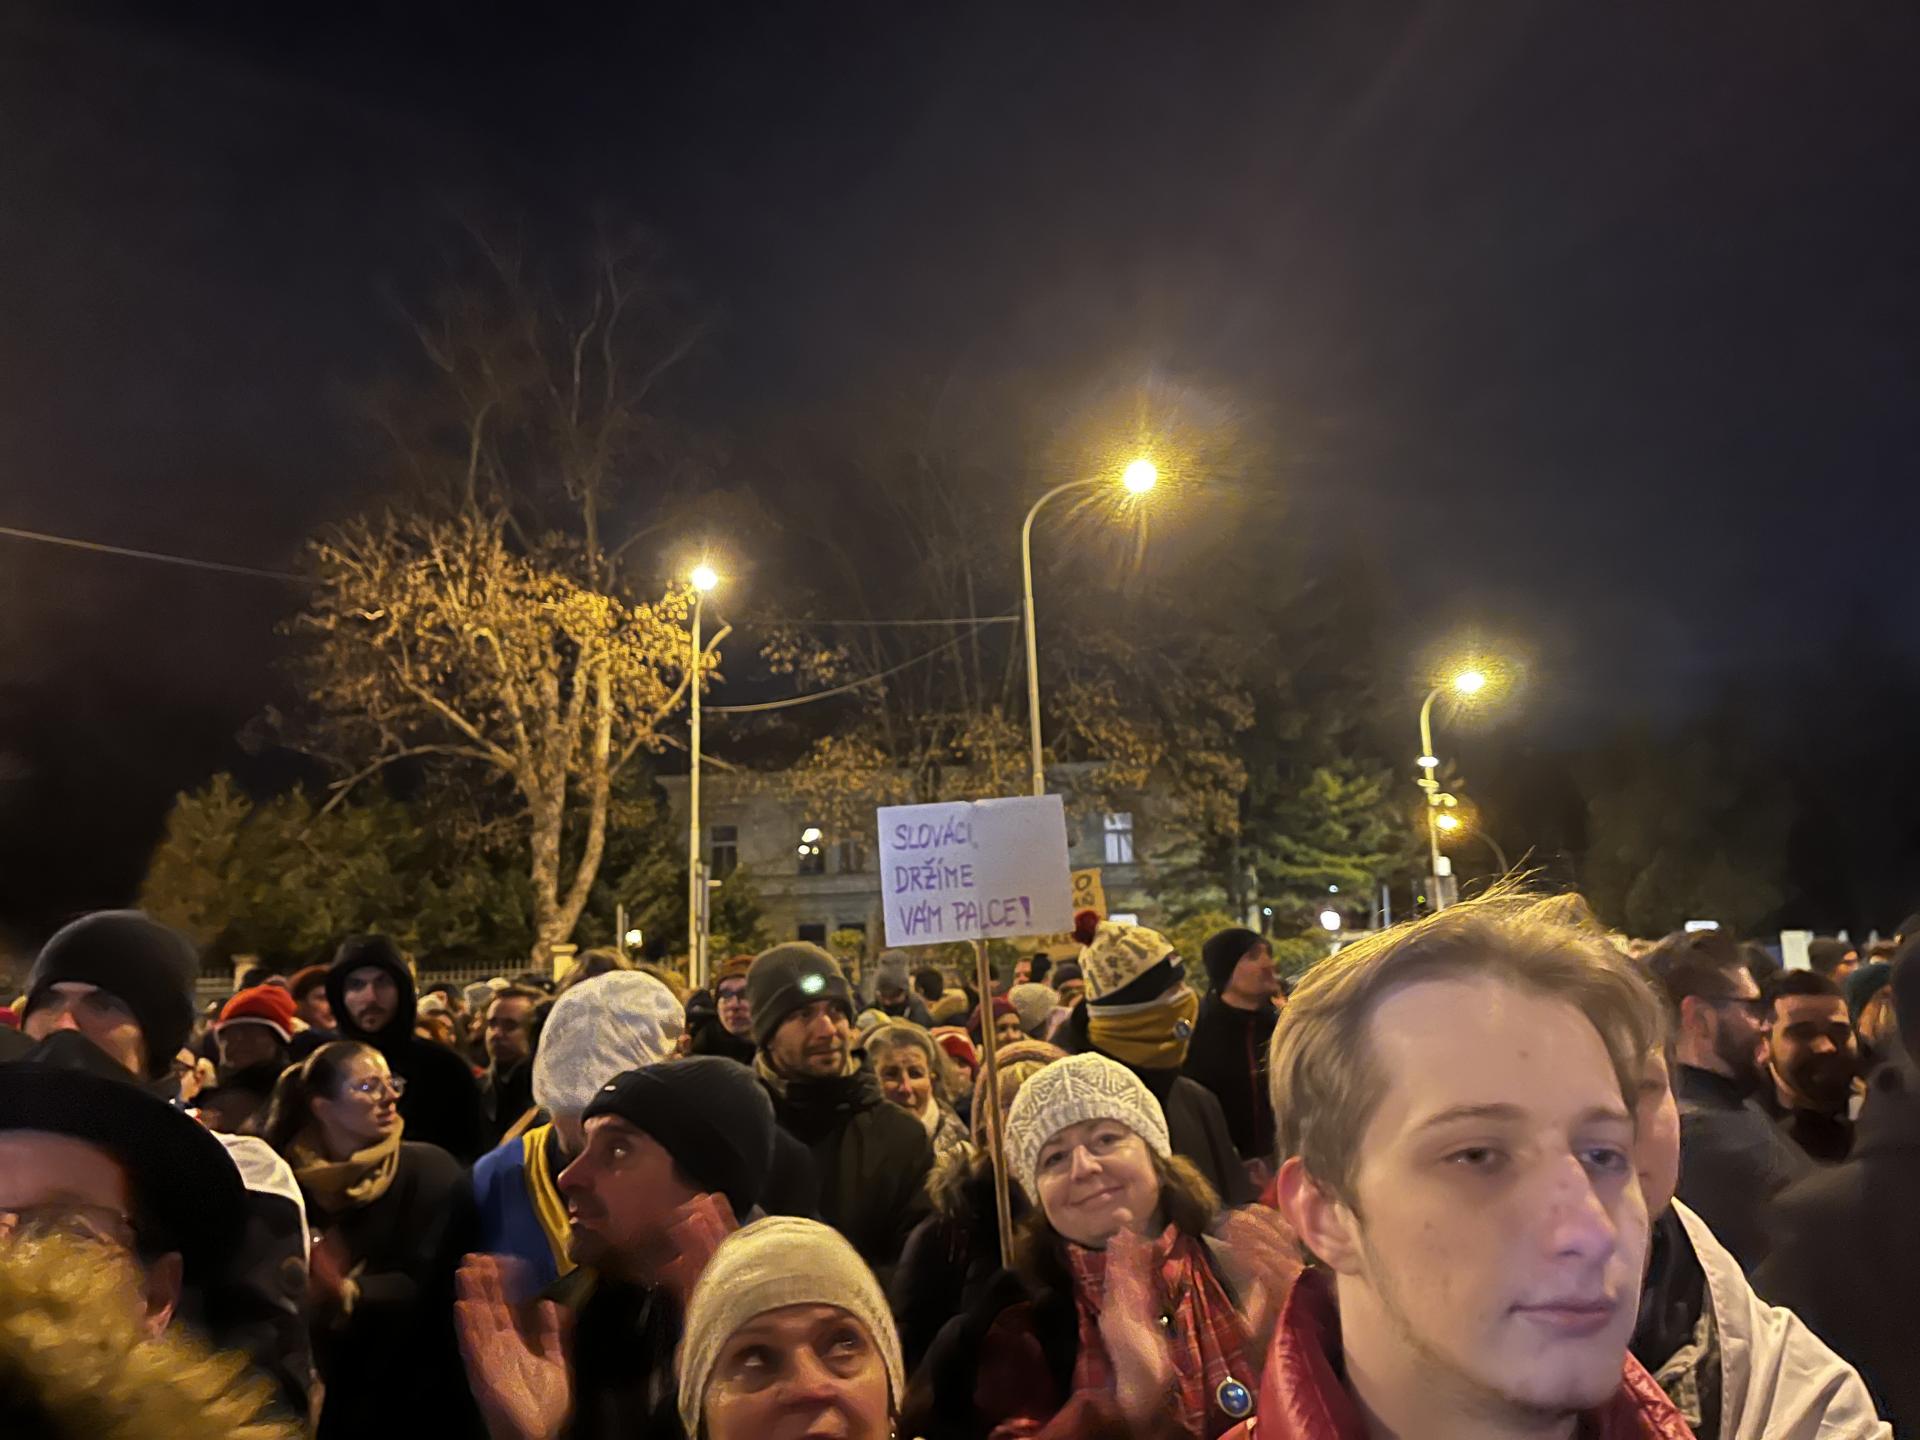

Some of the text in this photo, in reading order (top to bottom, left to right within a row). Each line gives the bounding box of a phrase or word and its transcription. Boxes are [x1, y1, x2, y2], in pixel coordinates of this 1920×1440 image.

[895, 857, 974, 894] DRŽÍME
[900, 900, 943, 935] VÁM
[952, 896, 1031, 932] PALCE!
